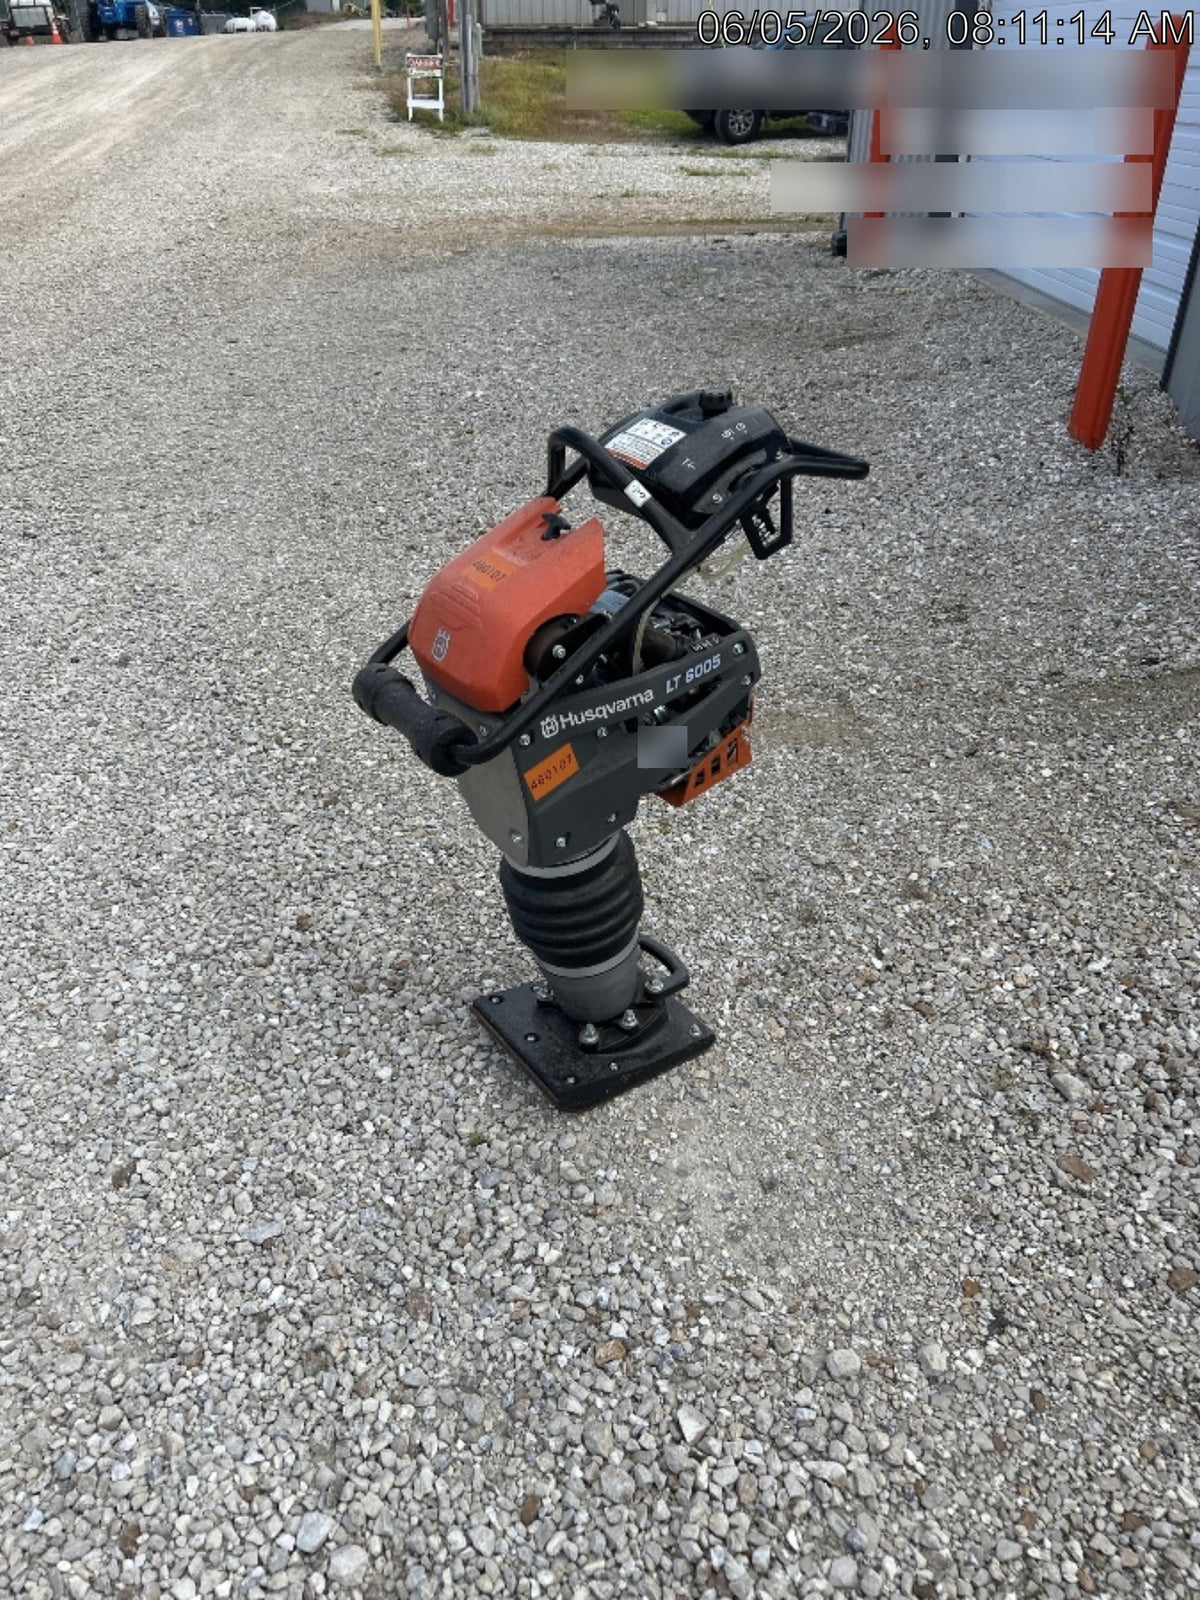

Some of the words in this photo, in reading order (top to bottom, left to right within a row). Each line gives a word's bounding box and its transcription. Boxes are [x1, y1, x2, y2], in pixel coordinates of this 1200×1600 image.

[559, 689, 655, 730] Husqvarna
[665, 674, 681, 695] LT
[685, 653, 722, 684] 6005
[529, 753, 574, 791] 460107
